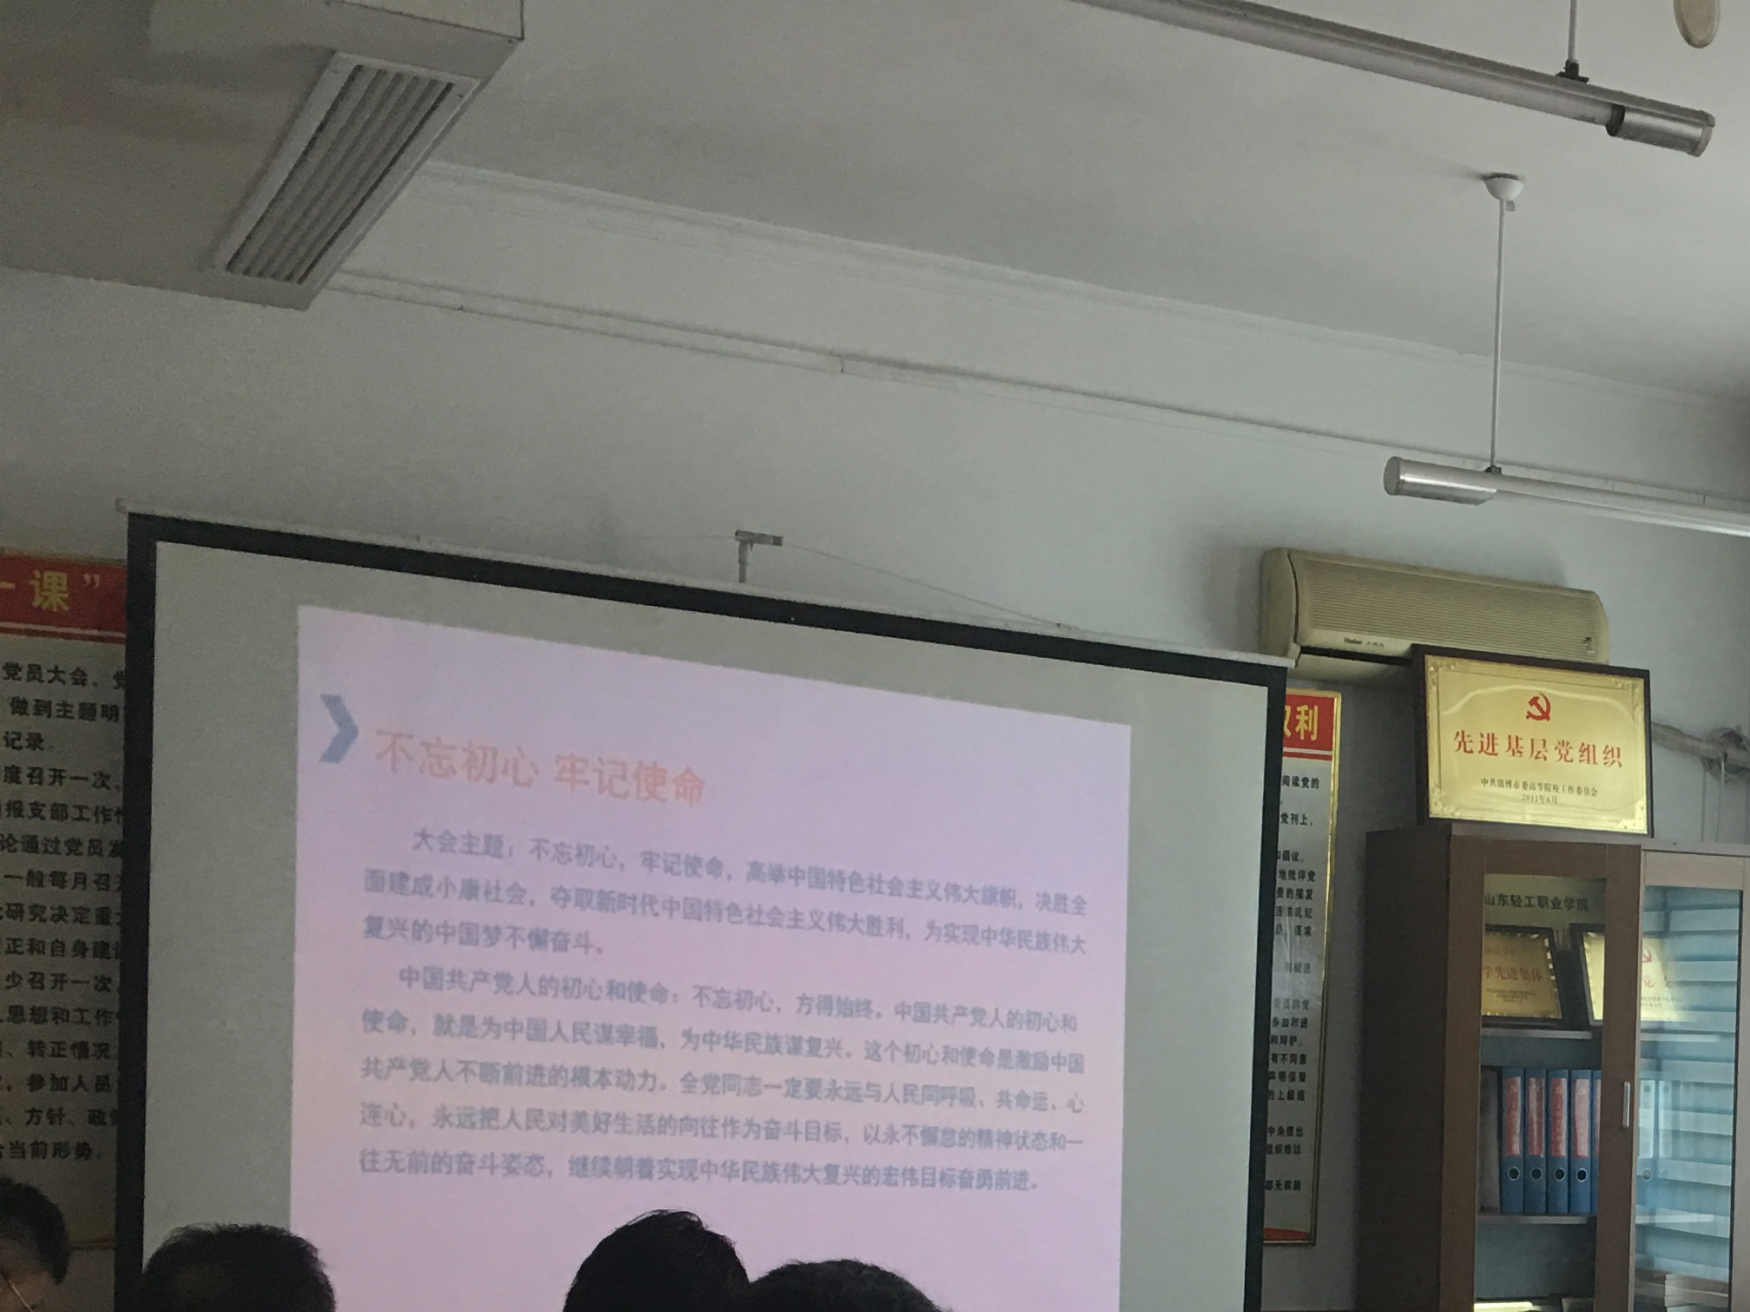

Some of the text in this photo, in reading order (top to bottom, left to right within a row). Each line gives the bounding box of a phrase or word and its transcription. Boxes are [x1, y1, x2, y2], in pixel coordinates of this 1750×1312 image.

[1453, 729, 1623, 769] 先进基层党组织
[374, 729, 706, 807] 不忘初心 牢记使命
[0, 800, 121, 824] 报支部工作
[0, 903, 121, 925] 研究决定重
[6, 937, 121, 960] 正和自身建
[0, 1005, 121, 1027] 思想和工作
[0, 1040, 111, 1060] 、转正情况
[0, 1106, 120, 1127] 、方针、政
